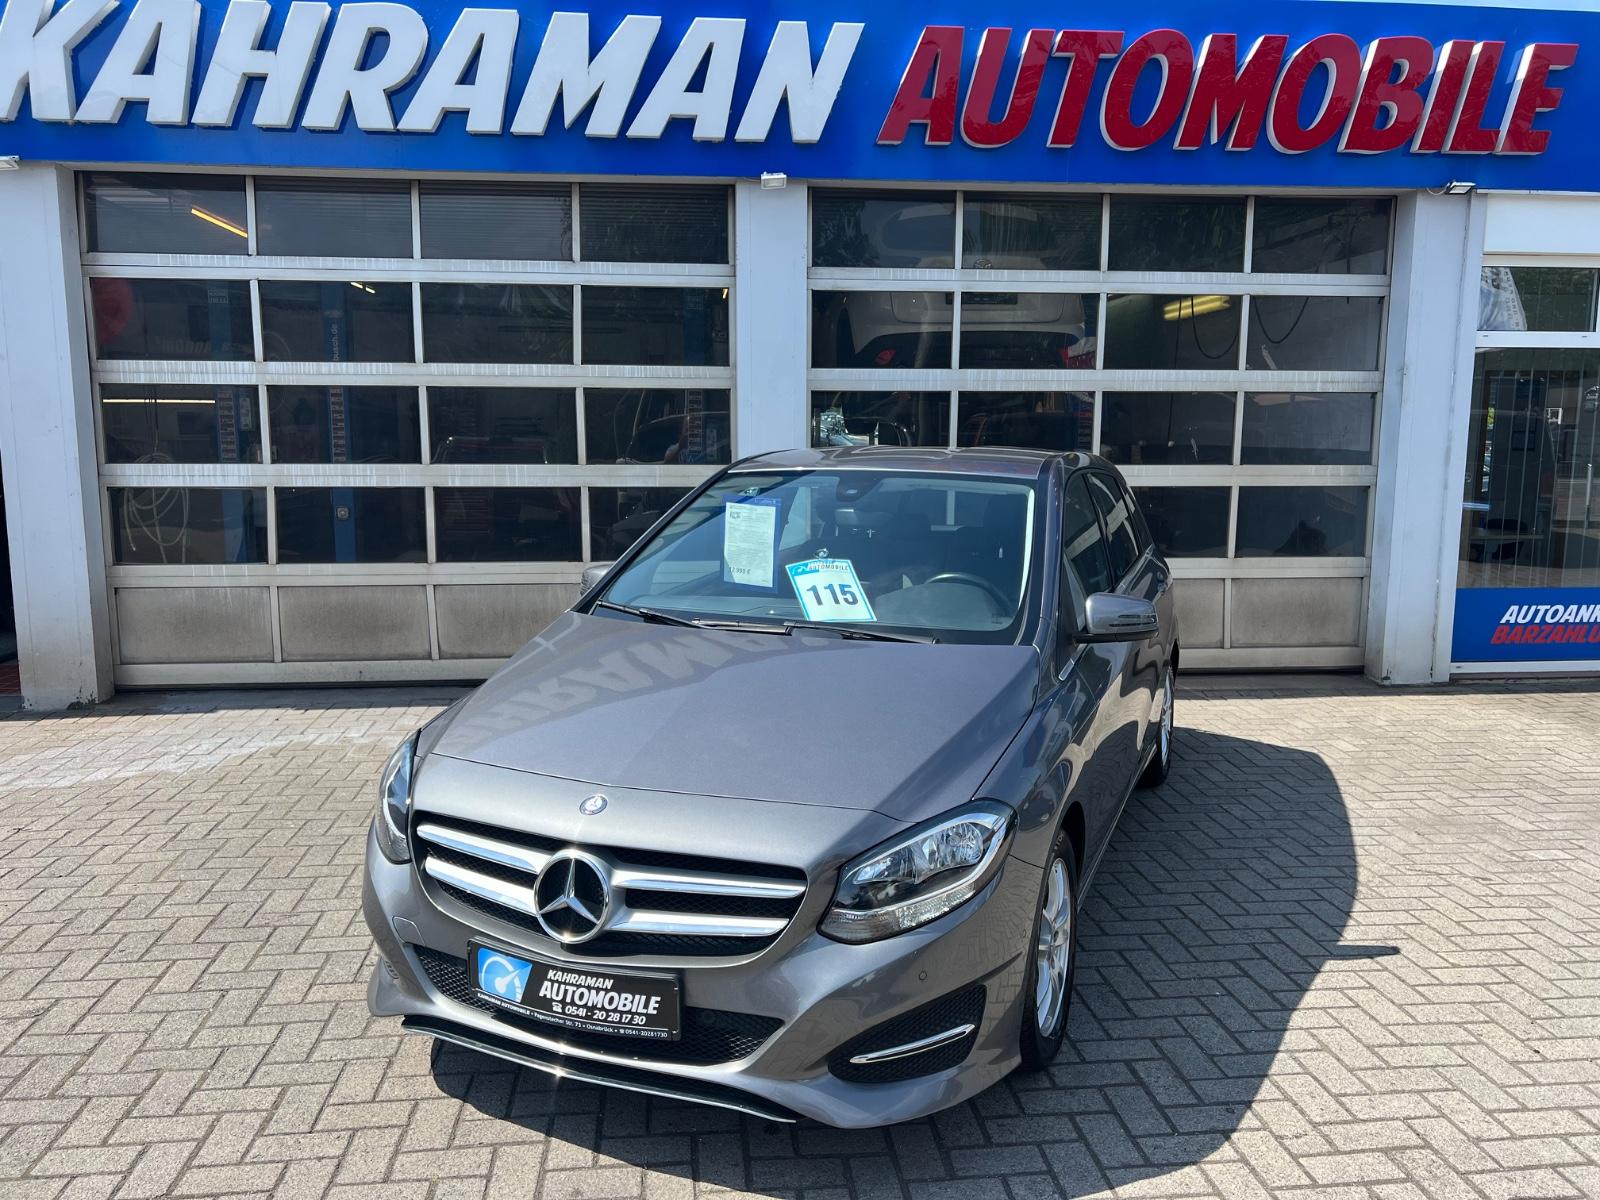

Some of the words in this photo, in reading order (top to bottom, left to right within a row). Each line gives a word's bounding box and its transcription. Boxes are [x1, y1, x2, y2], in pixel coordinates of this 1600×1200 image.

[0, 0, 865, 145] KAHRAMAN
[876, 25, 1580, 156] AUTOMOBILE
[806, 583, 858, 606] 115
[547, 969, 614, 990] KAHRAMAN
[538, 980, 661, 1015] AUTOMOBILE
[565, 1005, 587, 1017] 0541
[592, 1010, 606, 1020] 20
[607, 1012, 621, 1022] 28
[621, 1014, 633, 1023] 17
[632, 1015, 647, 1025] 30
